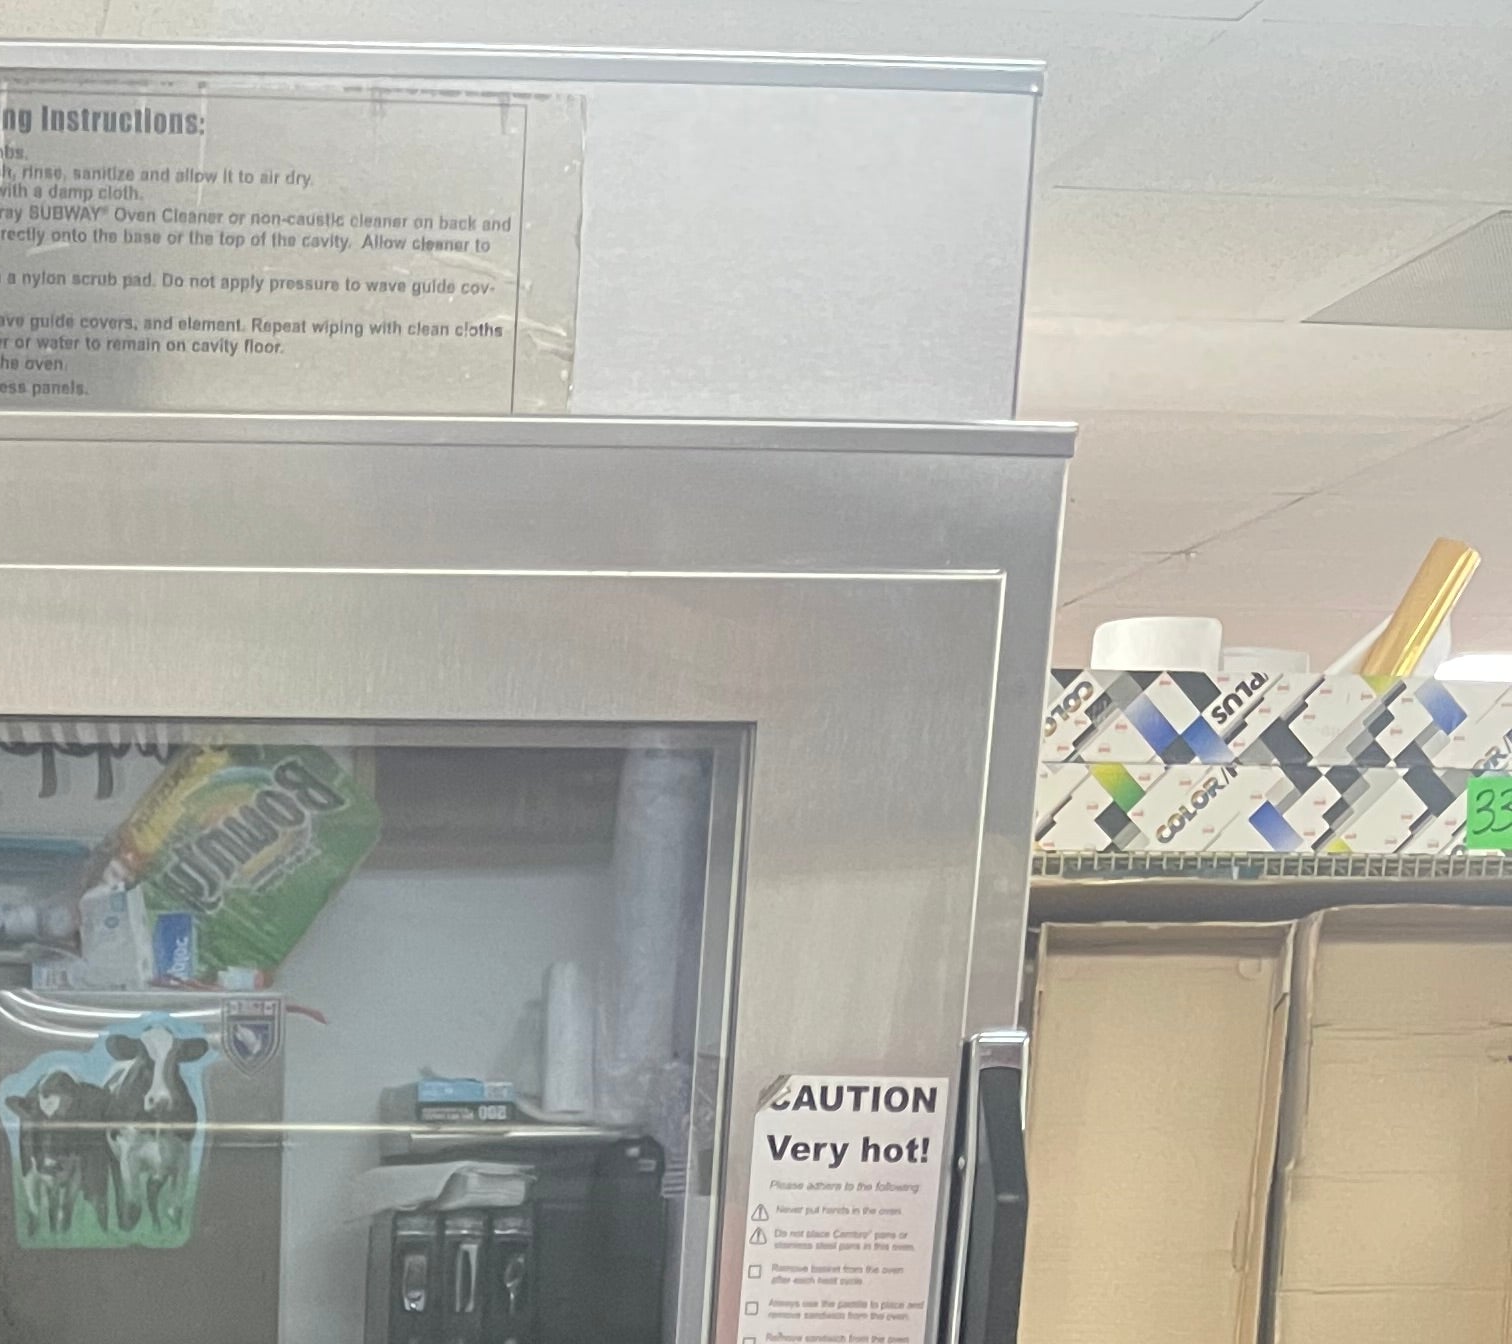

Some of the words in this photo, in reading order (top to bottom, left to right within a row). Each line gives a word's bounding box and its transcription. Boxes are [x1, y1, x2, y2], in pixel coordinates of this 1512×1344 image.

[41, 107, 205, 134] Instructions:
[113, 208, 156, 221] Oven
[161, 208, 224, 223] Cleaner
[228, 213, 246, 224] or
[349, 215, 408, 227] cleaner
[413, 218, 434, 228] on
[438, 216, 477, 230] back
[482, 217, 512, 232] and
[7, 273, 17, 284] a
[21, 272, 67, 288] nylon
[71, 273, 118, 285] scrub
[161, 273, 185, 287] Do
[189, 276, 216, 288] not
[220, 275, 265, 292] apply
[269, 279, 340, 291] pressure
[344, 278, 362, 291] to
[365, 282, 407, 291] wave
[411, 280, 456, 296] guide
[460, 284, 496, 294] cov-
[29, 315, 74, 330] guide
[143, 317, 173, 329] and
[251, 318, 307, 333] Repeat
[311, 321, 364, 337] wiping
[368, 321, 403, 334] with
[407, 322, 450, 335] clean
[14, 338, 31, 348] or
[36, 337, 80, 349] water
[84, 338, 102, 350] to
[106, 339, 161, 351] remain
[165, 341, 187, 351] on
[191, 339, 239, 356] cavity
[1210, 671, 1267, 725] PLUS
[767, 1135, 849, 1169] Very
[861, 1136, 930, 1164] hot!
